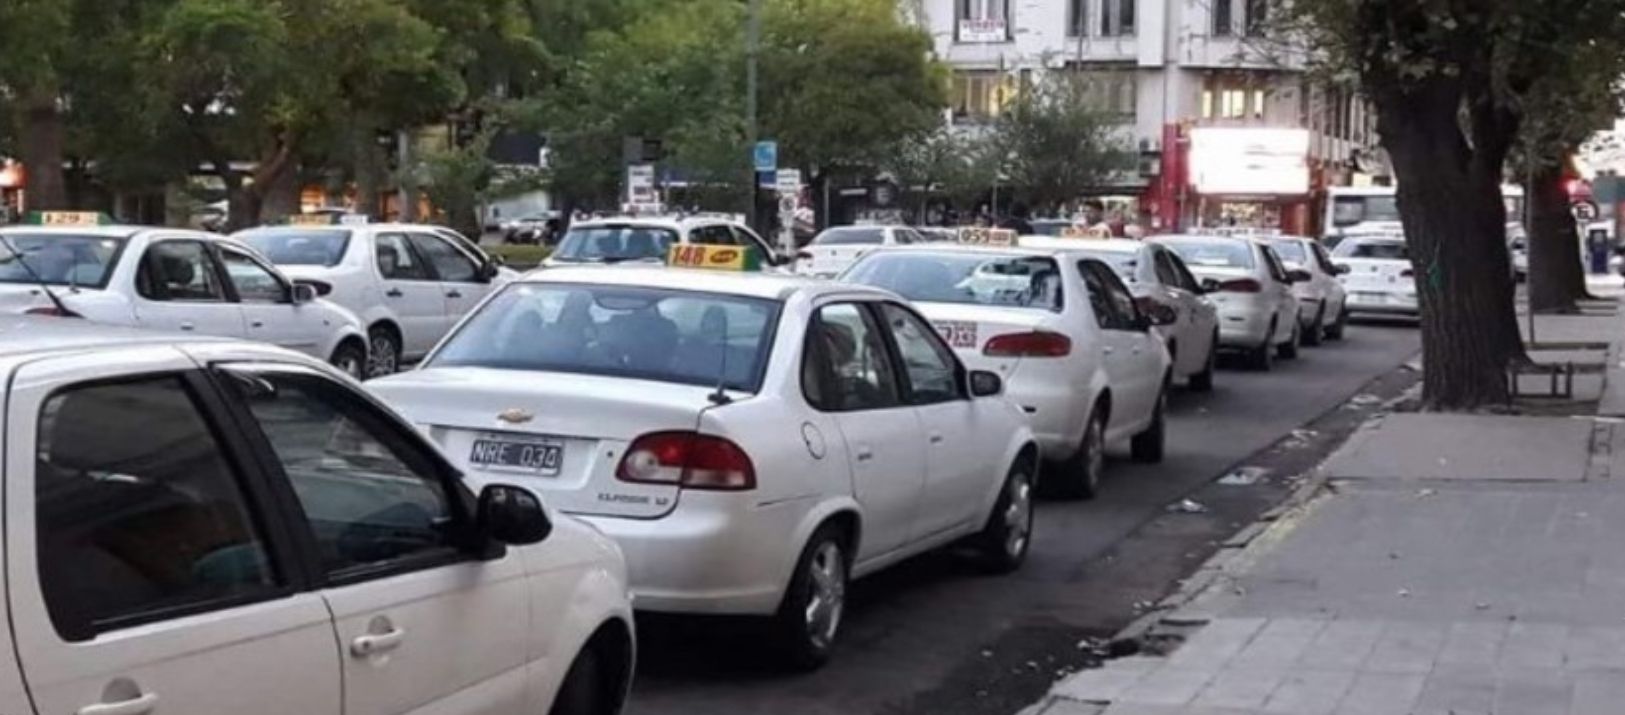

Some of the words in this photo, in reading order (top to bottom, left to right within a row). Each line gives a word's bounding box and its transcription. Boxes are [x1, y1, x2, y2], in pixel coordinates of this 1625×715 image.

[961, 229, 990, 244] 059
[672, 246, 706, 266] 148
[472, 441, 511, 465] NRE
[520, 446, 558, 468] 034
